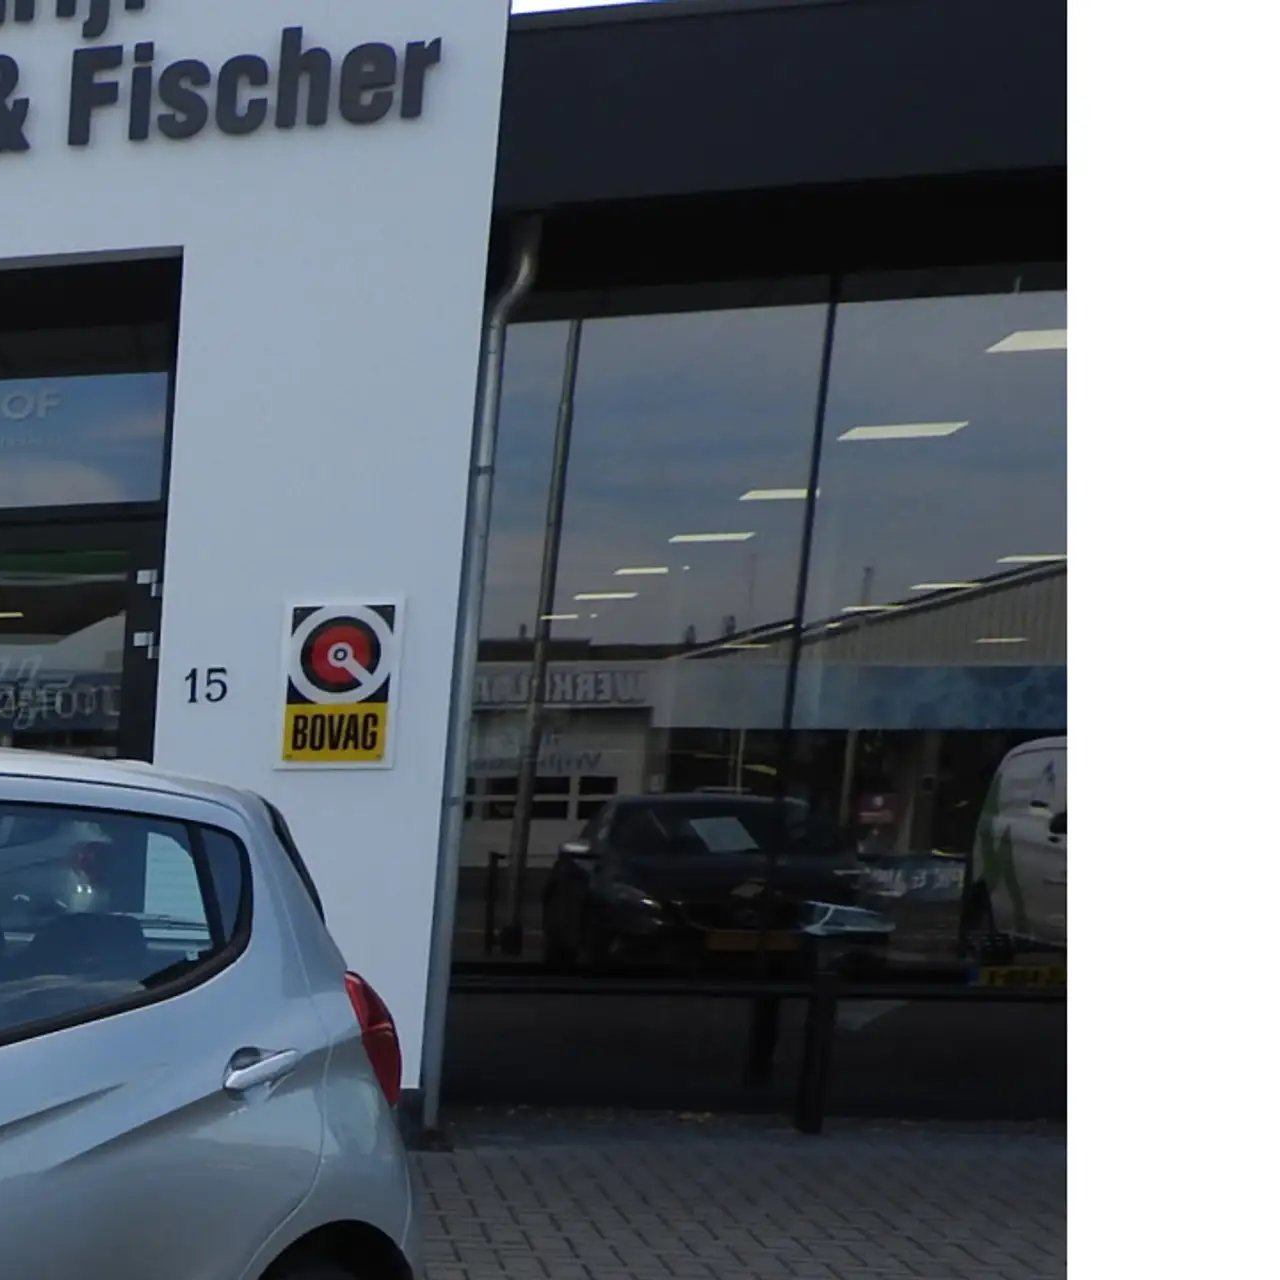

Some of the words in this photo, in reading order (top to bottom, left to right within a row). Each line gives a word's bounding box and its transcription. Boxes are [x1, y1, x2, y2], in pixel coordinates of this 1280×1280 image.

[67, 26, 440, 146] Fischer
[184, 666, 228, 704] 15
[291, 712, 378, 751] BOVAG
